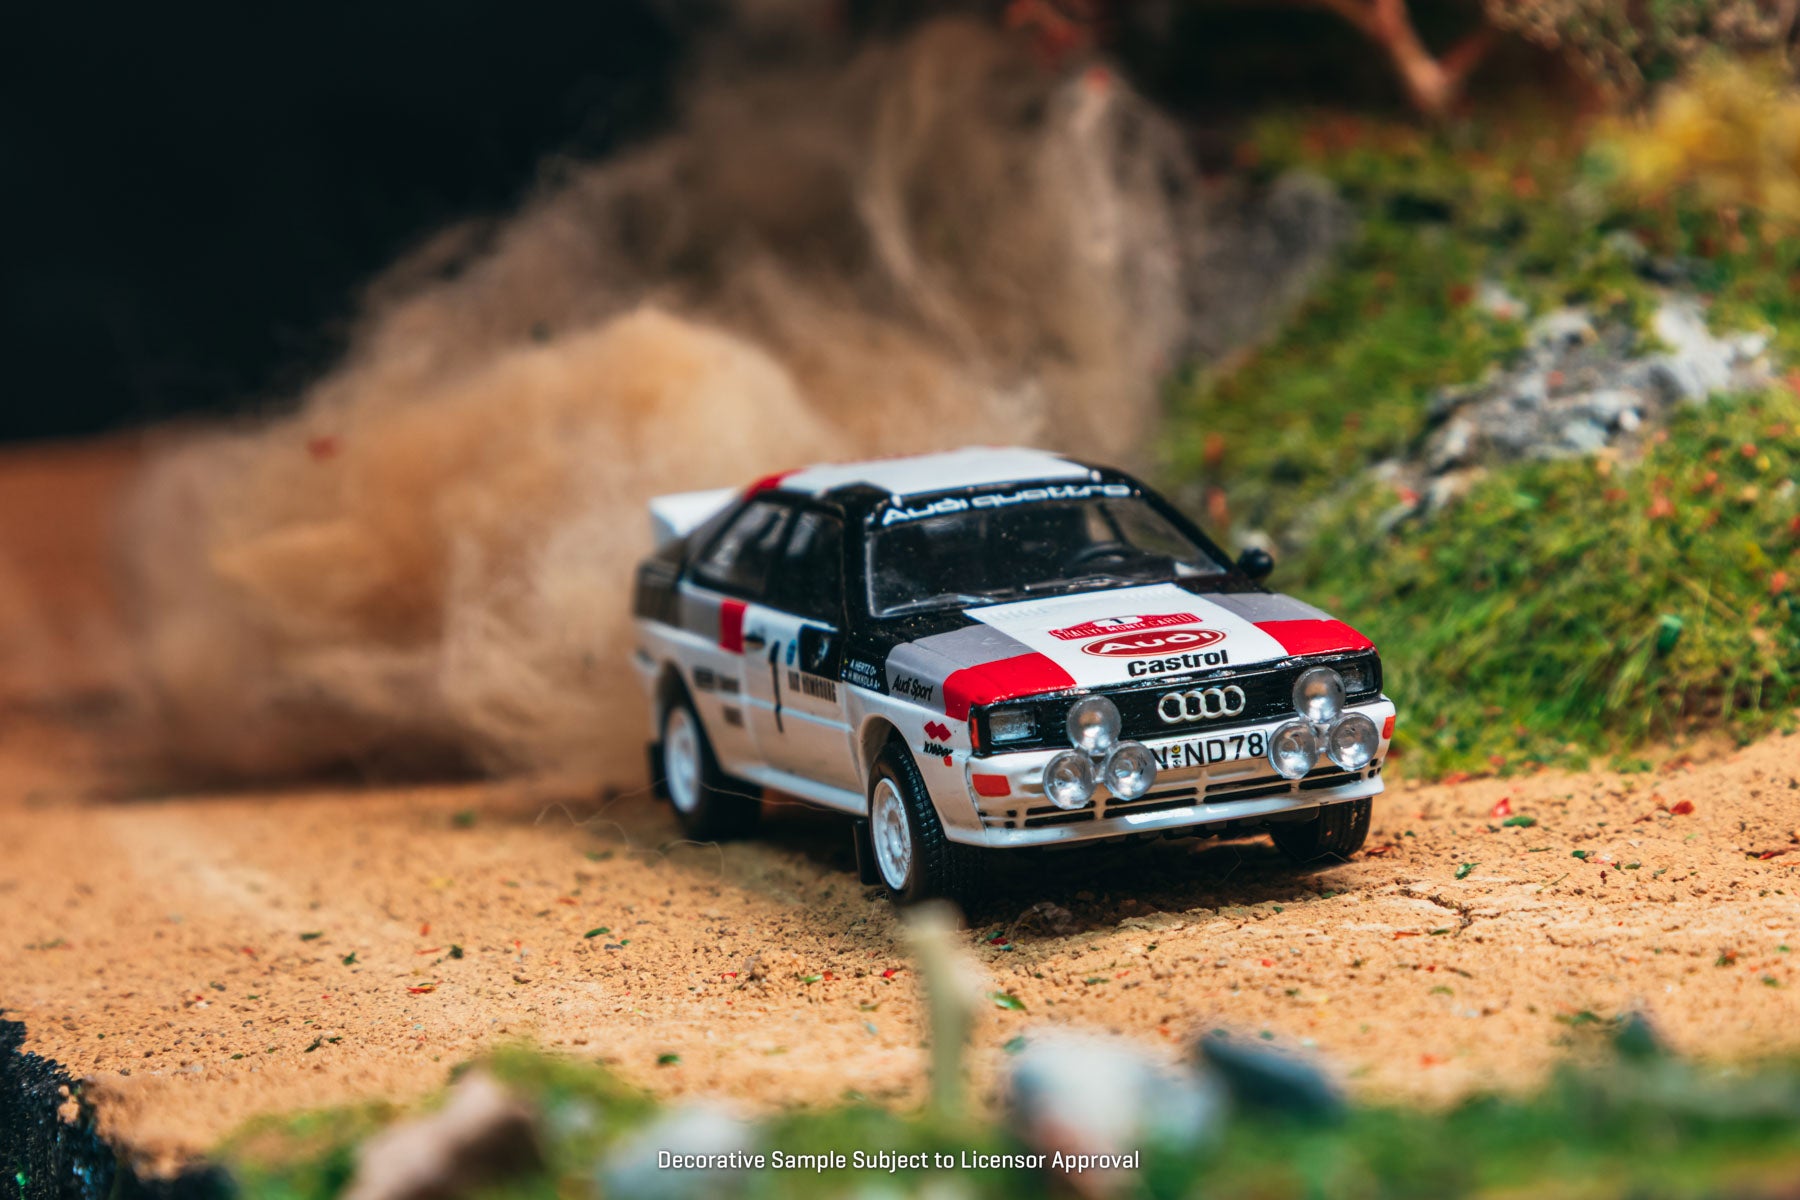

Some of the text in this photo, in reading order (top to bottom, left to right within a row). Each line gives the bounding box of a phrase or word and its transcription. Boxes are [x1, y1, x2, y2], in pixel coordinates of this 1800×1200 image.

[881, 484, 1131, 527] Audi quattro
[1106, 622, 1147, 632] MONTE
[1127, 649, 1229, 678] Castrol
[893, 674, 934, 701] Audi Sport
